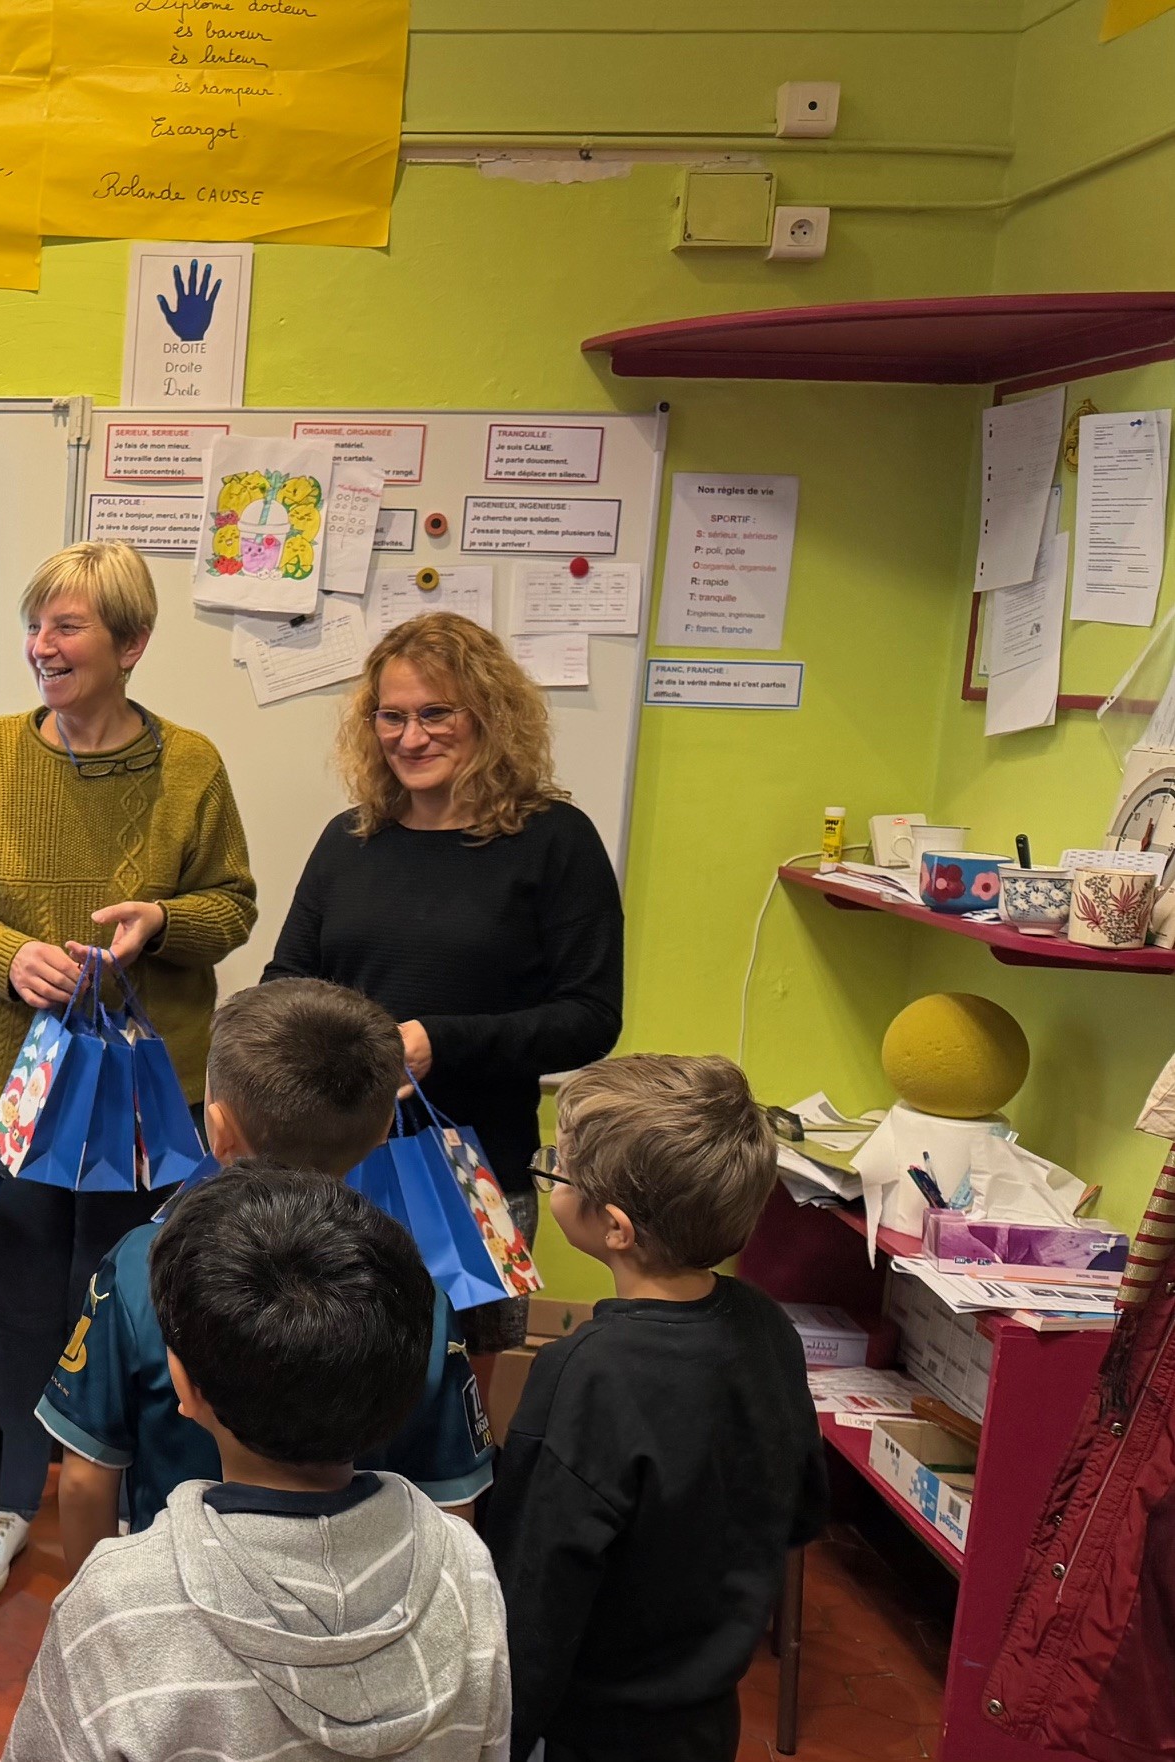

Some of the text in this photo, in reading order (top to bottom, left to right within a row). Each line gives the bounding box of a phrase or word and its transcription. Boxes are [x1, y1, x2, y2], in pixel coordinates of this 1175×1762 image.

[248, 0, 318, 17] docteur
[205, 21, 273, 41] baveur
[168, 45, 268, 68] ès lenteur
[93, 172, 264, 206] Rolande CAUSSE
[163, 343, 206, 353] DROITE
[165, 362, 202, 373] Droite
[164, 377, 201, 396] Droite
[498, 430, 546, 438] TRANQUILLE
[505, 457, 524, 465] parle
[518, 470, 546, 478] déplace
[698, 486, 715, 494] Nos
[747, 487, 759, 495] de
[761, 488, 774, 496] vie
[710, 515, 750, 524] SPORTIF
[131, 524, 148, 533] doigt
[725, 547, 745, 556] polie
[703, 578, 729, 587] rapide
[699, 593, 737, 603] tranquille
[722, 625, 753, 634] franche
[687, 666, 724, 674] FRANCHE
[761, 681, 786, 689] parfois
